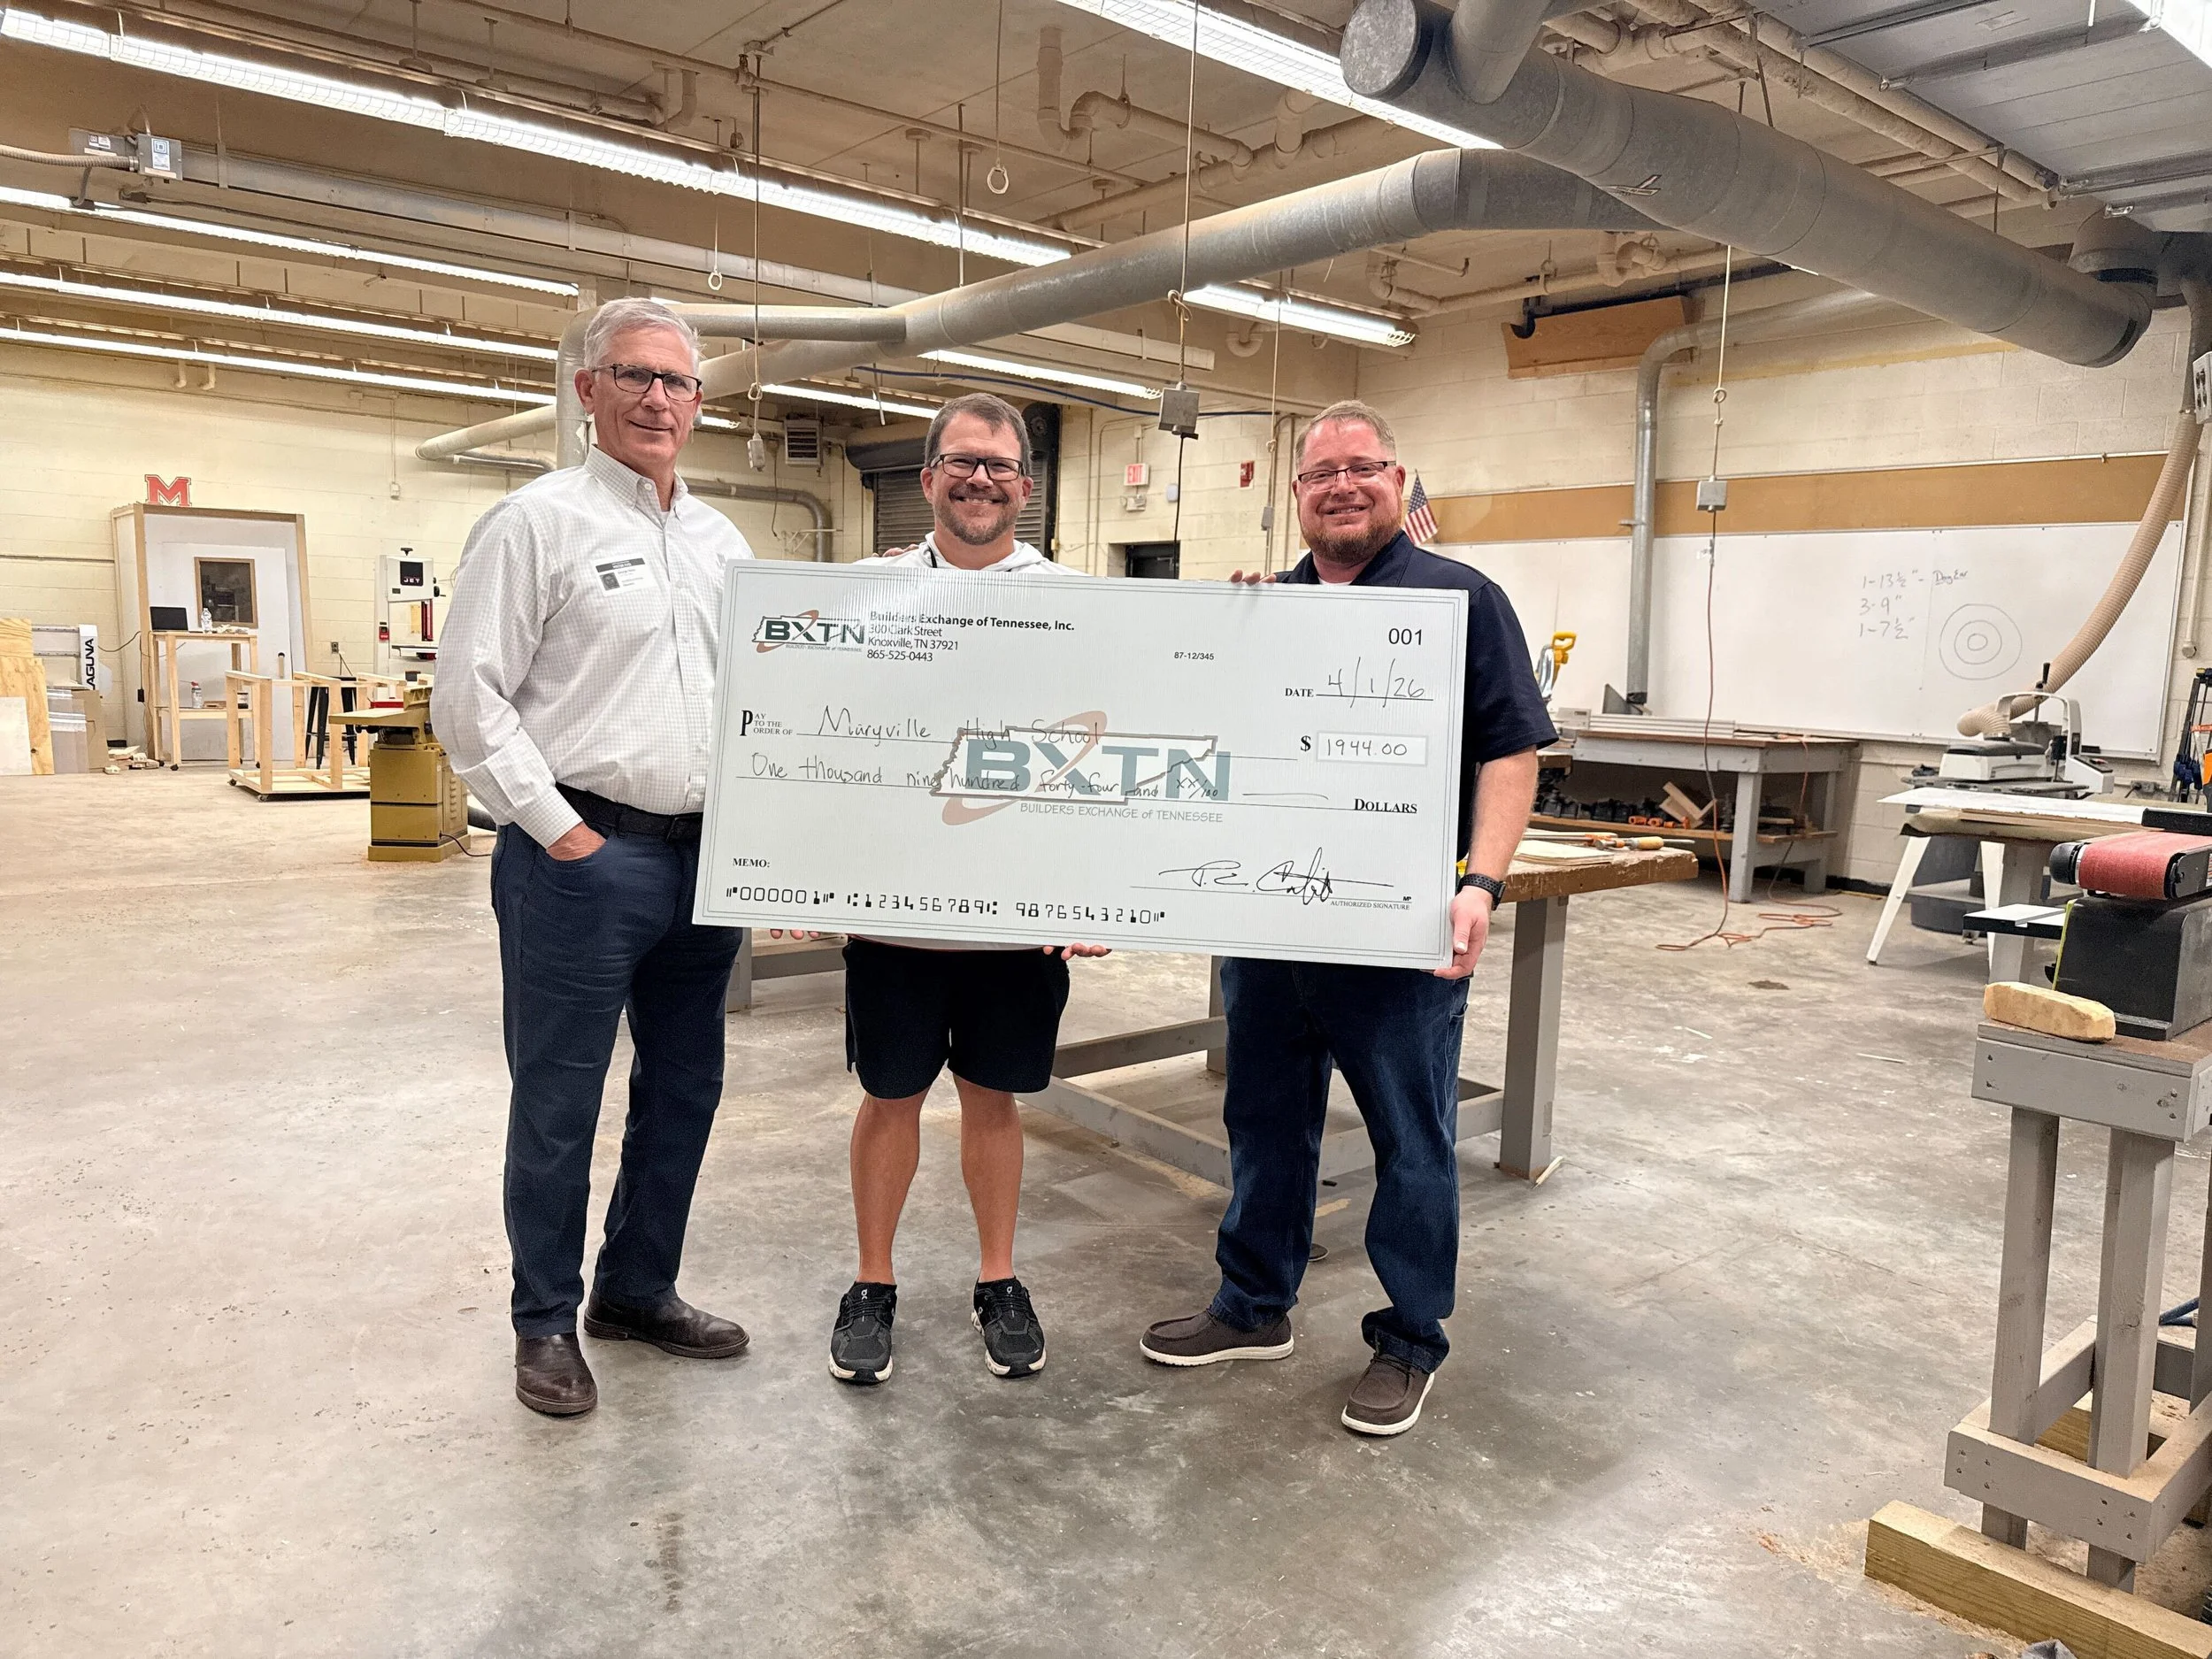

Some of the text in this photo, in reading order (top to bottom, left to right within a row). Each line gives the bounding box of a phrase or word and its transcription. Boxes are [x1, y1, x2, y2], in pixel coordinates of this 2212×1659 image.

[1126, 465, 1143, 483] EXIT
[144, 474, 192, 507] M
[888, 624, 913, 635] Cark
[913, 626, 942, 637] Street
[918, 613, 973, 627] Exchange
[976, 616, 988, 626] of
[990, 617, 1052, 631] Tennessee,
[1055, 620, 1075, 631] Inc.
[764, 619, 865, 644] BXTN
[1388, 627, 1423, 645] 001
[868, 636, 958, 650] Knoxville, TN 37921
[867, 649, 933, 662] 865-525-0443
[1173, 651, 1215, 661] 87-12/345
[1327, 656, 1425, 709] 4/1/26
[1285, 687, 1314, 697] DATE
[818, 705, 1099, 750] Maryville High School
[1300, 735, 1311, 751] $
[1327, 739, 1408, 757] 1944.00
[751, 752, 787, 779] One
[798, 754, 883, 784] thousand
[906, 770, 941, 787] nine
[949, 768, 1020, 791] hundred
[1134, 784, 1159, 797] and
[964, 738, 1232, 802] BXTN
[1020, 803, 1224, 823] BUILDERS EXCHANGE of TENNESSEE
[733, 857, 771, 868] MEMO:
[1330, 900, 1372, 909] AUTHORIZED
